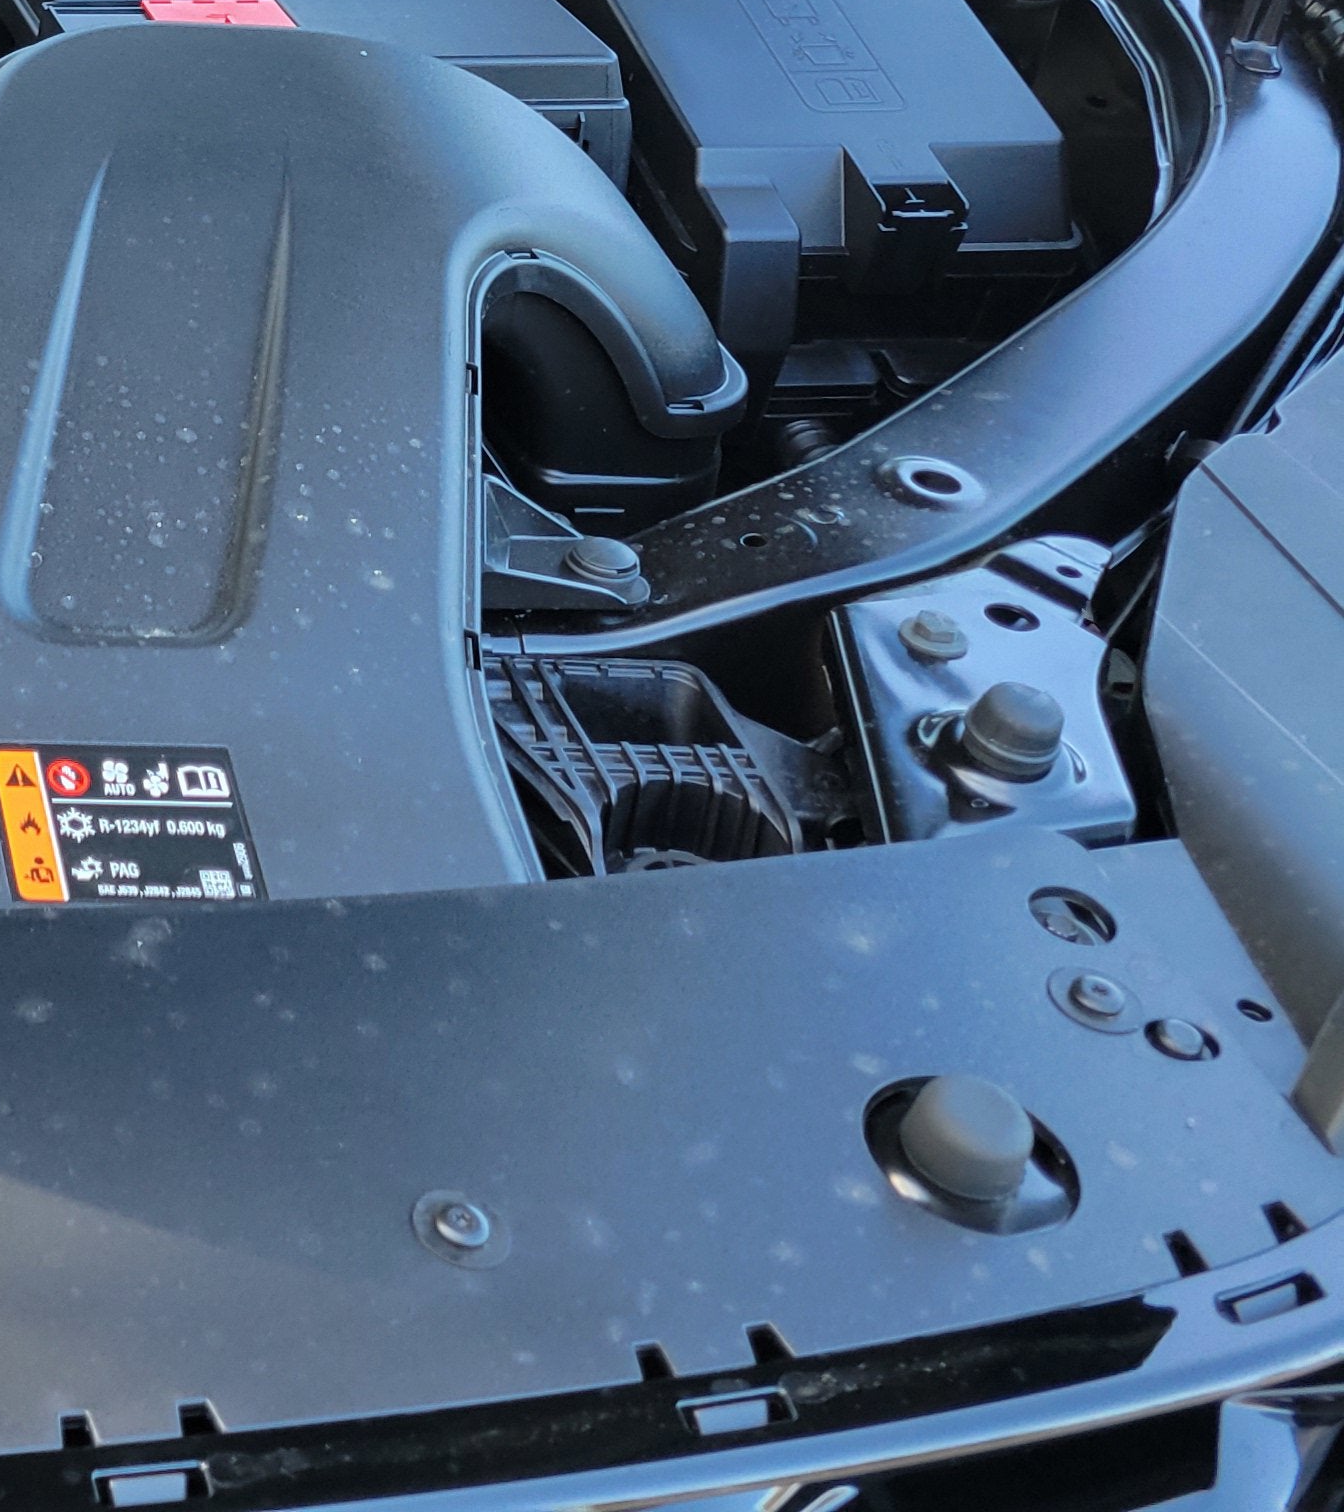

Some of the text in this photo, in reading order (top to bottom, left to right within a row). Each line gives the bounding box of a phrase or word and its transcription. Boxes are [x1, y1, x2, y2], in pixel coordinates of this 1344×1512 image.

[104, 783, 136, 796] AUTO
[98, 818, 226, 838] R-1234yf 0.600 kg
[109, 861, 140, 879] PAG
